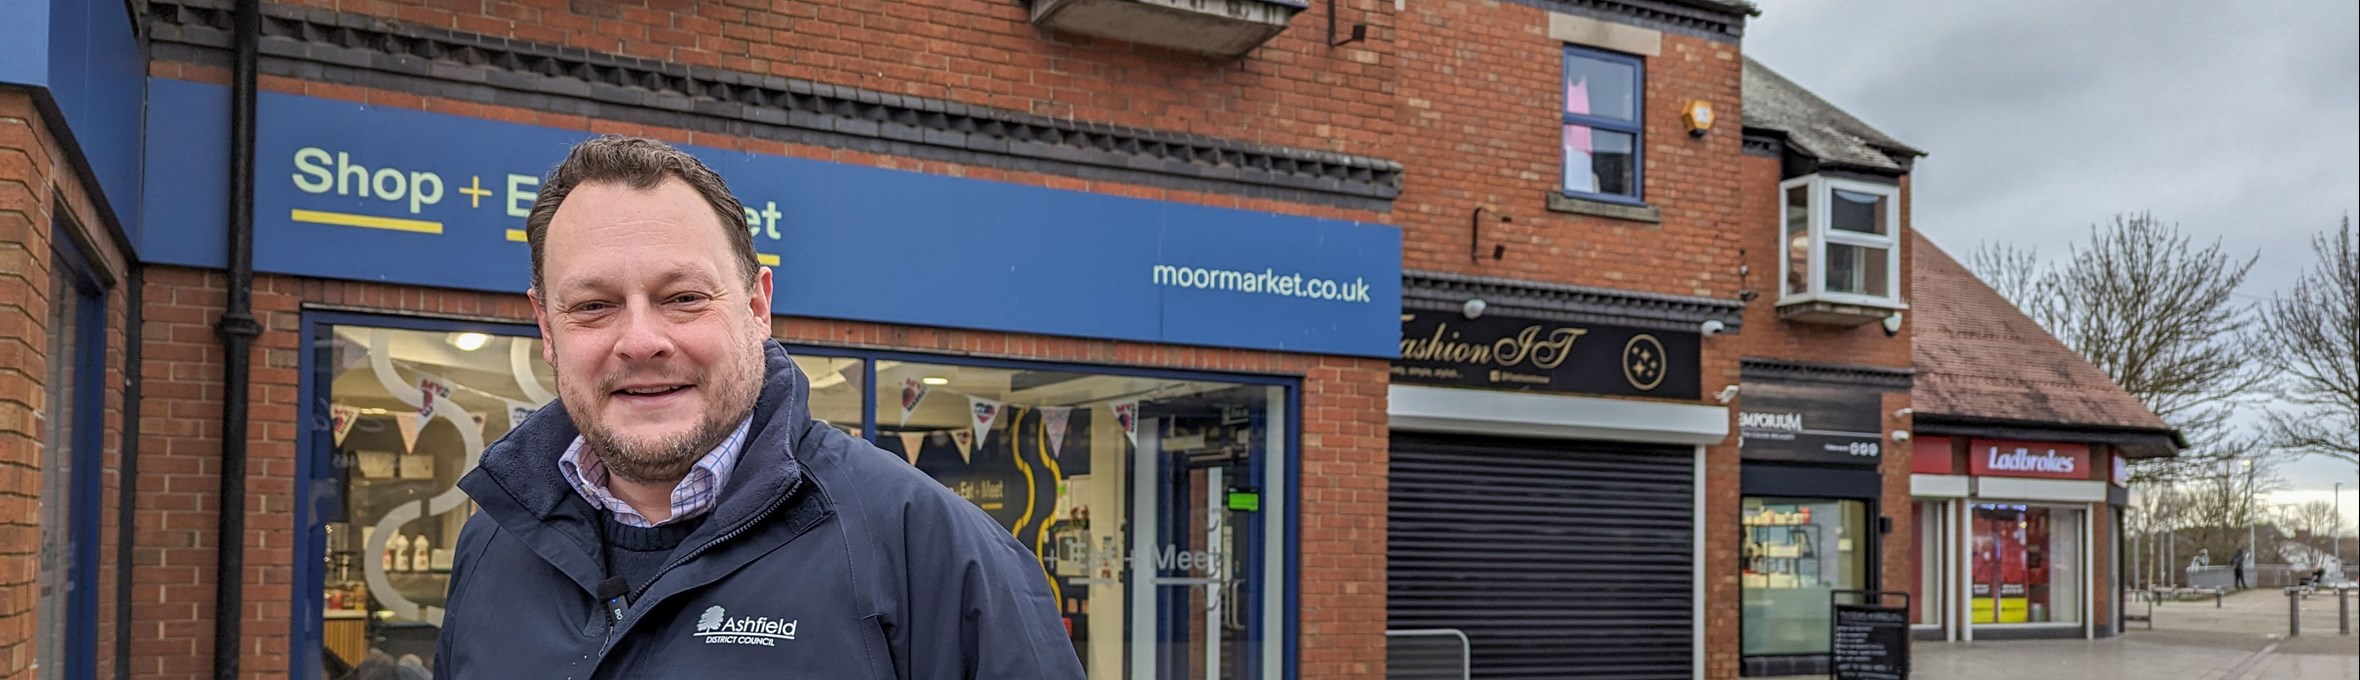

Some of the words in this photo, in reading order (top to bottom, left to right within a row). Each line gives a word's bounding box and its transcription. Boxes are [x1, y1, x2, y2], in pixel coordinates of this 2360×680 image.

[292, 147, 444, 214] Shop
[743, 200, 782, 240] et
[1153, 264, 1371, 303] moormarket.co.uk
[1988, 446, 2074, 473] Ladbrokes
[1151, 543, 1223, 571] Meet
[721, 616, 797, 636] Ashfield
[705, 635, 737, 644] DISTRICT
[738, 636, 775, 646] COUNCIL
